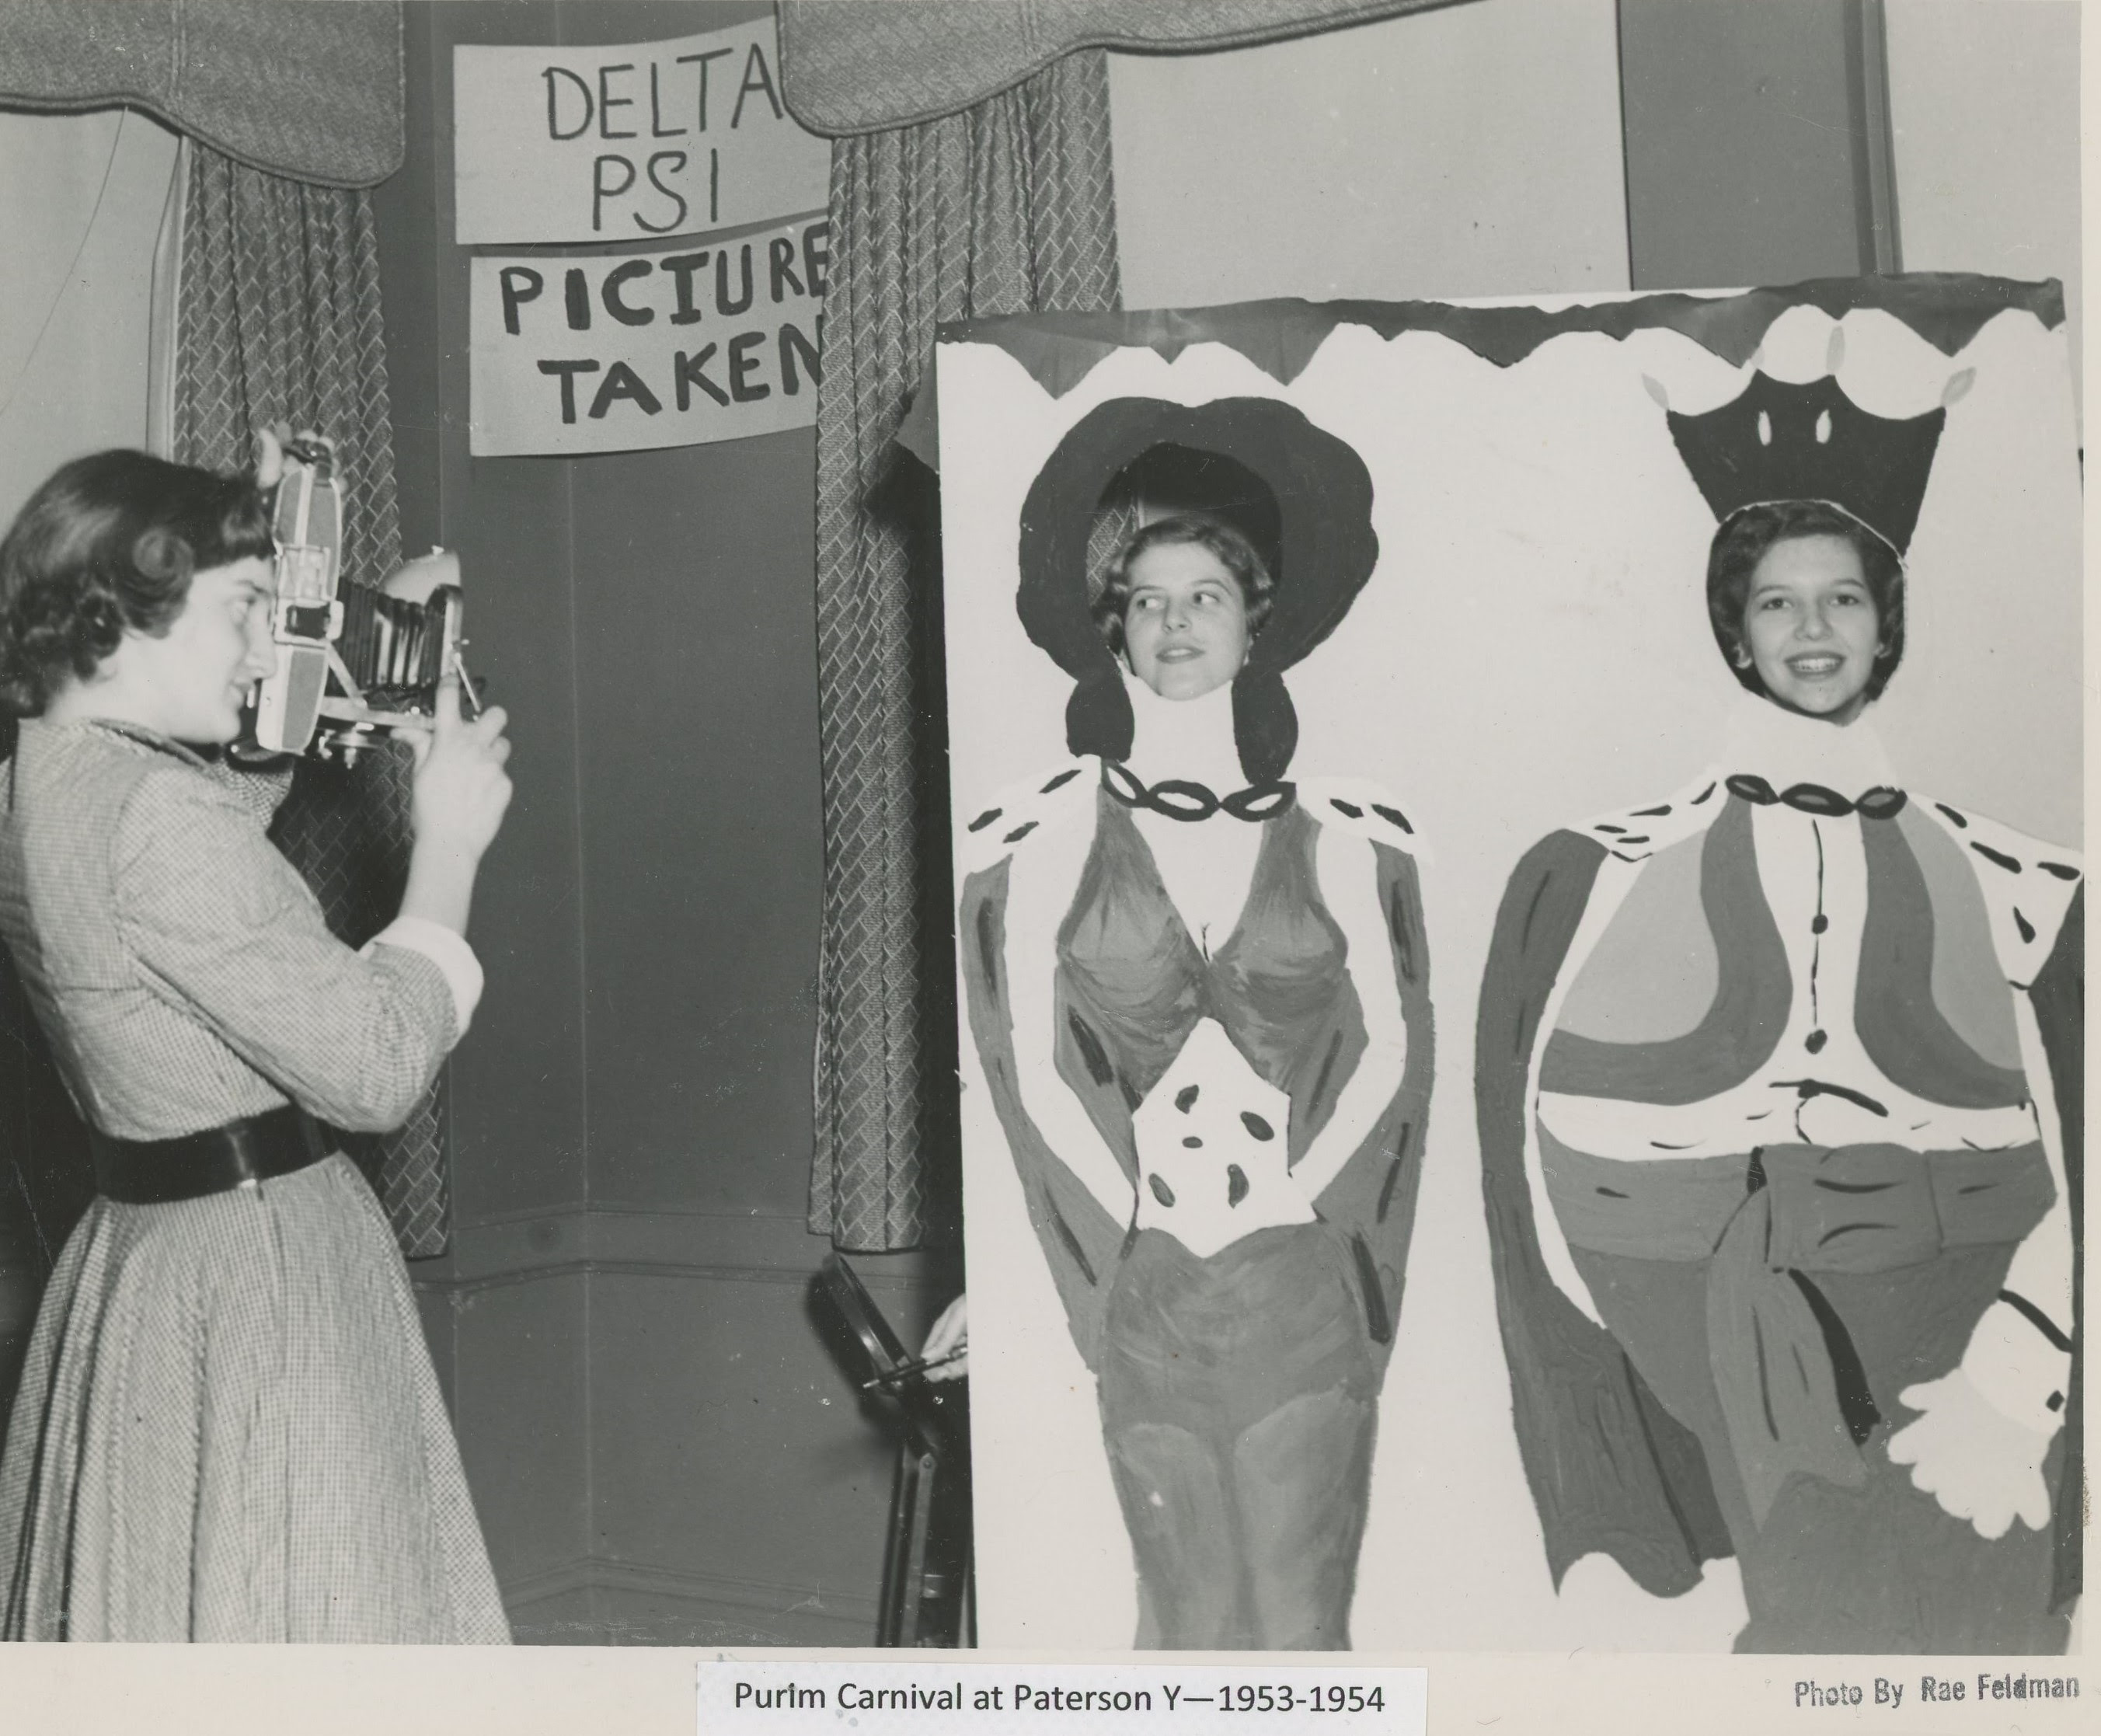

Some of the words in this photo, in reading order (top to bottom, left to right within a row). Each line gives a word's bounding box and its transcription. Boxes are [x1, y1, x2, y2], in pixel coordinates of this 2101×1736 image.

[541, 43, 784, 141] DELTA
[592, 148, 718, 233] PSI
[499, 221, 828, 336] PICTURE
[537, 314, 824, 424] TAKEN
